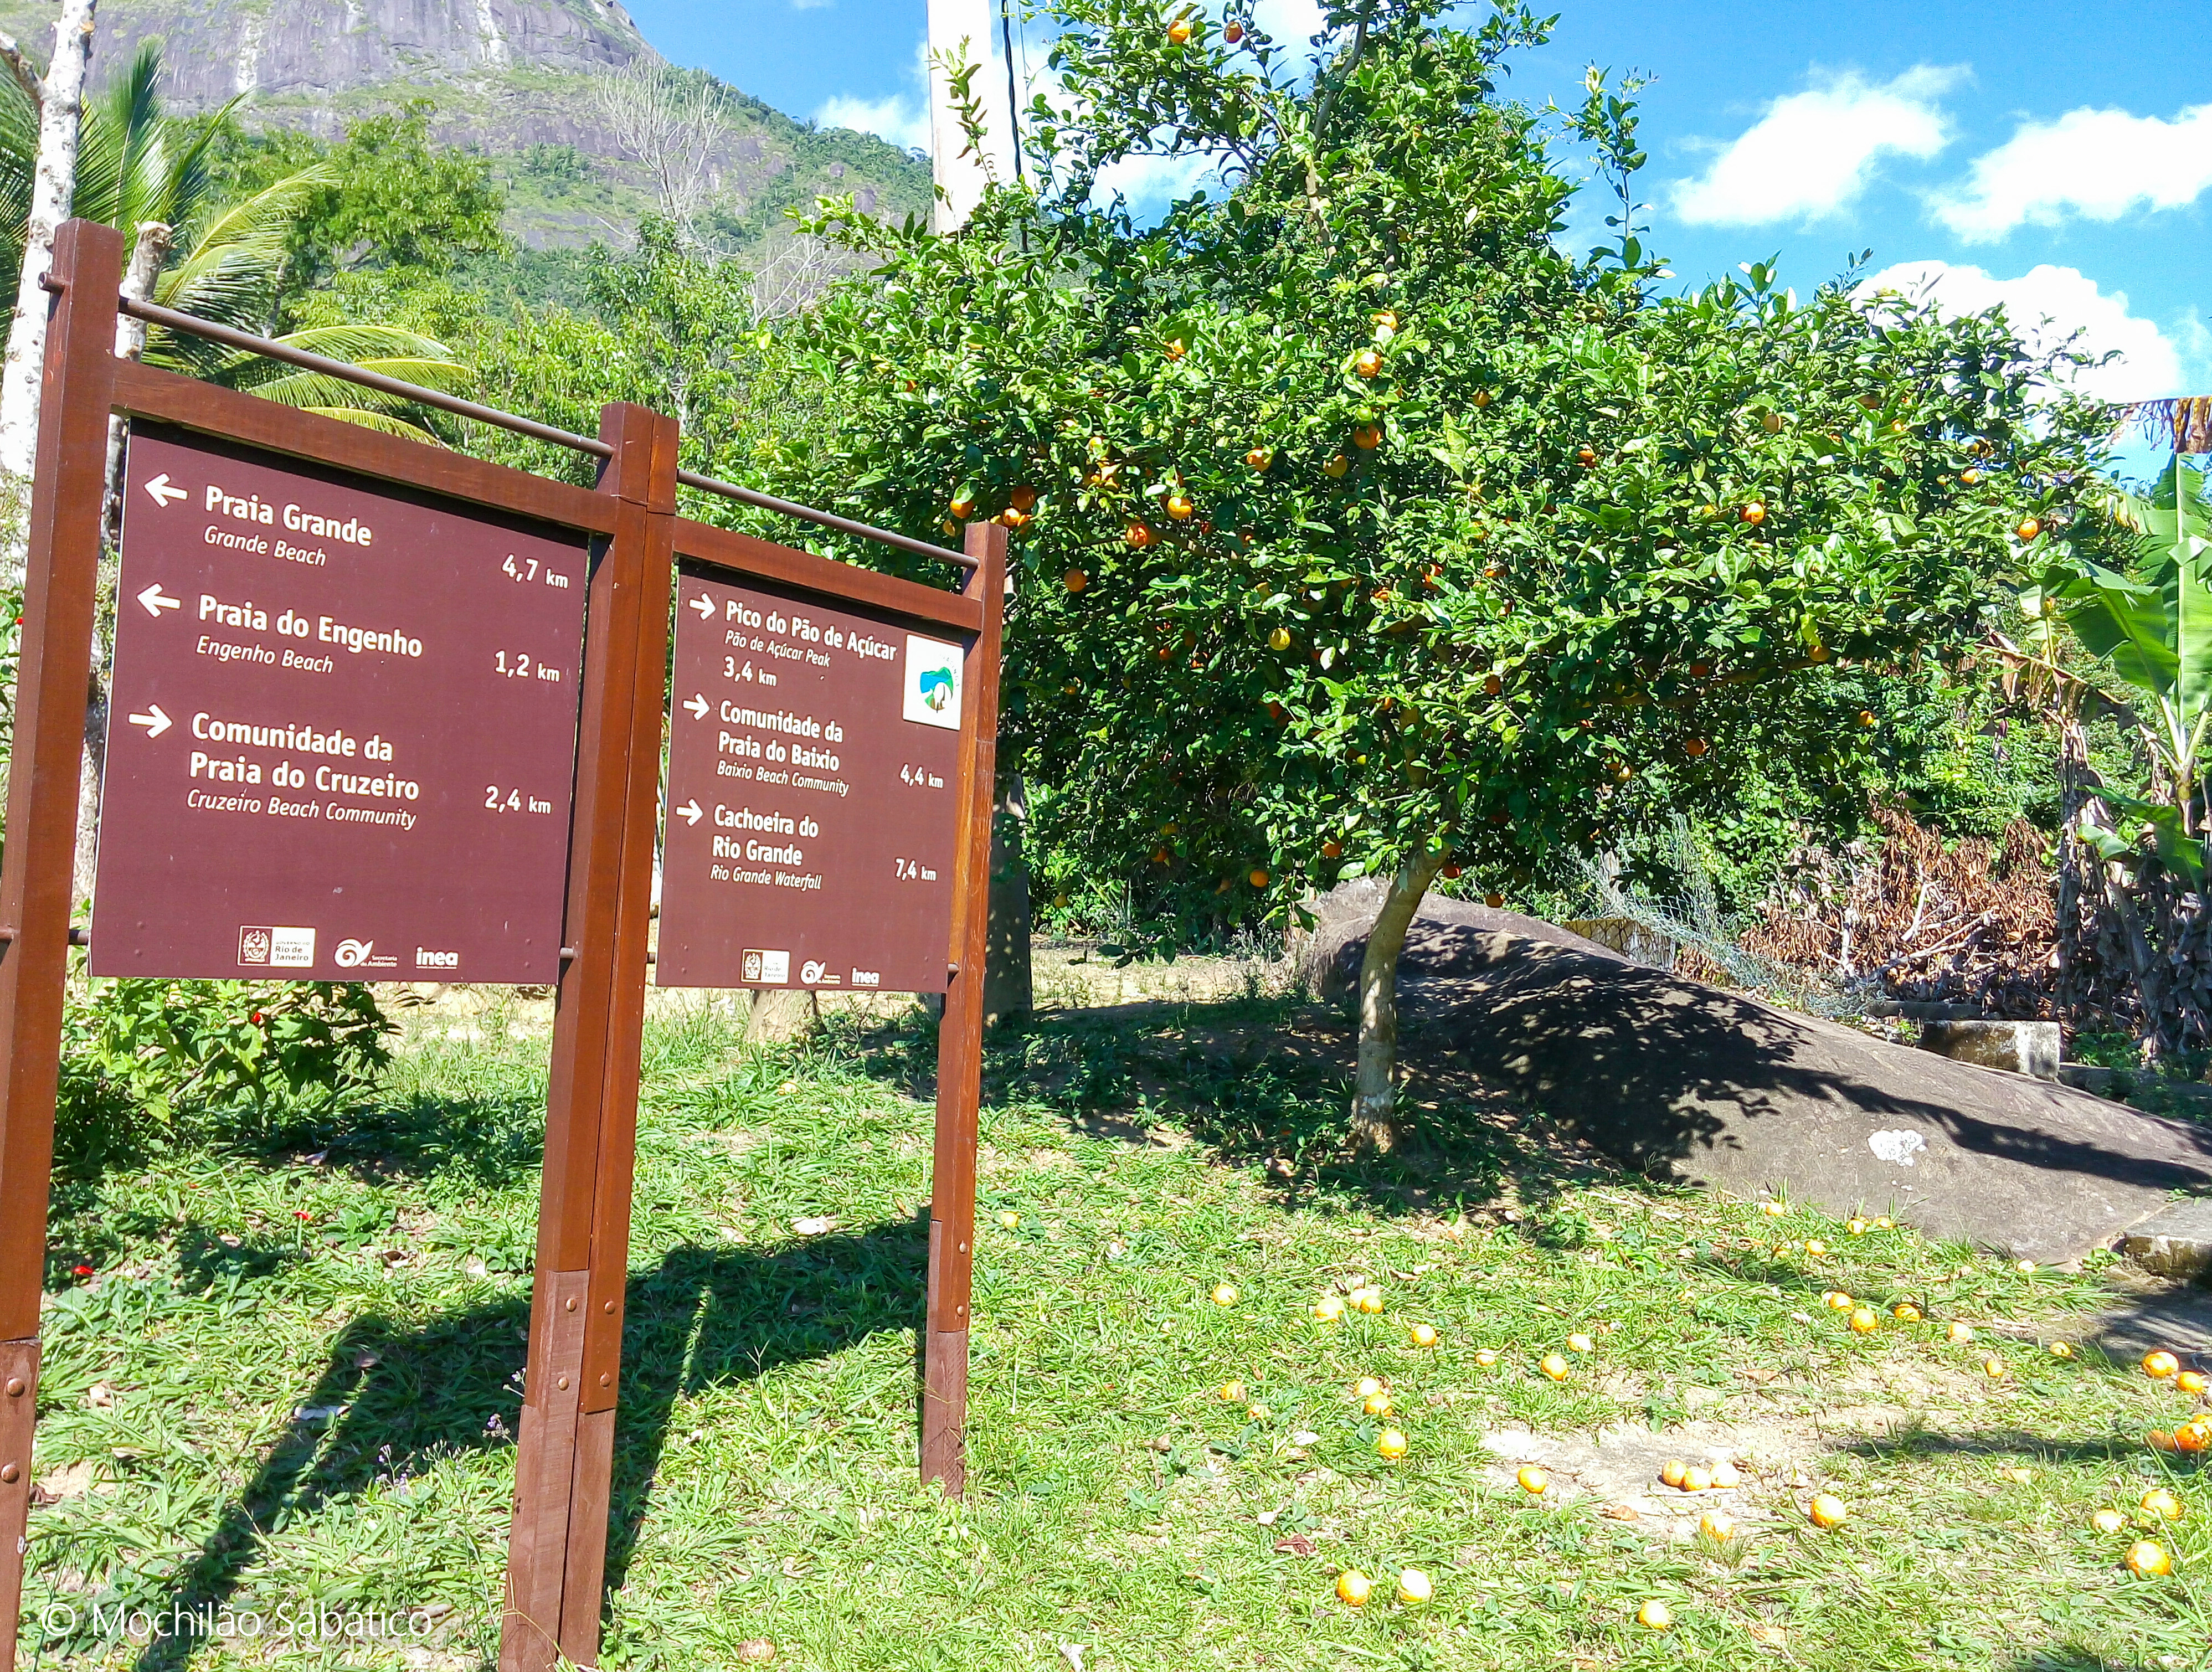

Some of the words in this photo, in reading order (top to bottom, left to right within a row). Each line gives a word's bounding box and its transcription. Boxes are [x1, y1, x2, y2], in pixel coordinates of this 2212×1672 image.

[205, 485, 274, 525] Praia
[282, 503, 372, 546] Grande
[204, 524, 269, 555] Grande
[273, 539, 326, 567] Beach
[502, 554, 539, 583] 4,7
[546, 568, 569, 589] km
[199, 594, 268, 631] Praia
[276, 609, 310, 638] do
[318, 615, 423, 657] Engenho
[726, 600, 762, 629] Pico
[765, 610, 787, 635] do
[791, 616, 820, 642] Pão
[824, 625, 843, 649] de
[846, 631, 897, 661] Açúcar
[196, 635, 276, 665] Engenho
[281, 649, 333, 674] Beach
[495, 650, 530, 678] 1,2
[537, 662, 560, 682] km
[724, 629, 747, 649] Pão
[749, 635, 764, 652] de
[765, 639, 804, 661] Açúcar
[805, 648, 831, 668] Peak
[723, 655, 753, 683] 3,4
[758, 668, 777, 687] km
[192, 712, 357, 757] Comunidade
[363, 734, 393, 762] da
[720, 699, 821, 739] Comunidade
[824, 720, 843, 743] da
[718, 730, 761, 759] Praia
[765, 739, 786, 763] do
[791, 743, 840, 771] Baixio
[189, 751, 261, 784] Praia
[271, 760, 306, 789] do
[315, 765, 419, 800] Cruzeiro
[717, 759, 753, 780] Baixio
[755, 765, 789, 785] Beach
[791, 771, 850, 798] Community
[900, 763, 925, 787] 4,4
[928, 772, 944, 789] km
[187, 788, 261, 814] Cruzeiro
[266, 796, 320, 819] Beach
[325, 801, 417, 831] Community
[485, 785, 522, 814] 2,4
[528, 795, 552, 815] km
[714, 804, 794, 835] Cachoeira
[798, 815, 819, 838] do
[712, 835, 741, 860] Rio
[745, 838, 803, 866] Grande
[709, 864, 730, 881] Rio
[732, 866, 772, 885] Grande
[774, 870, 822, 892] Waterfall
[896, 858, 917, 881] 7,4
[920, 865, 937, 882] km
[275, 953, 309, 961] Janeiro
[415, 946, 459, 966] inea
[851, 967, 879, 984] inea
